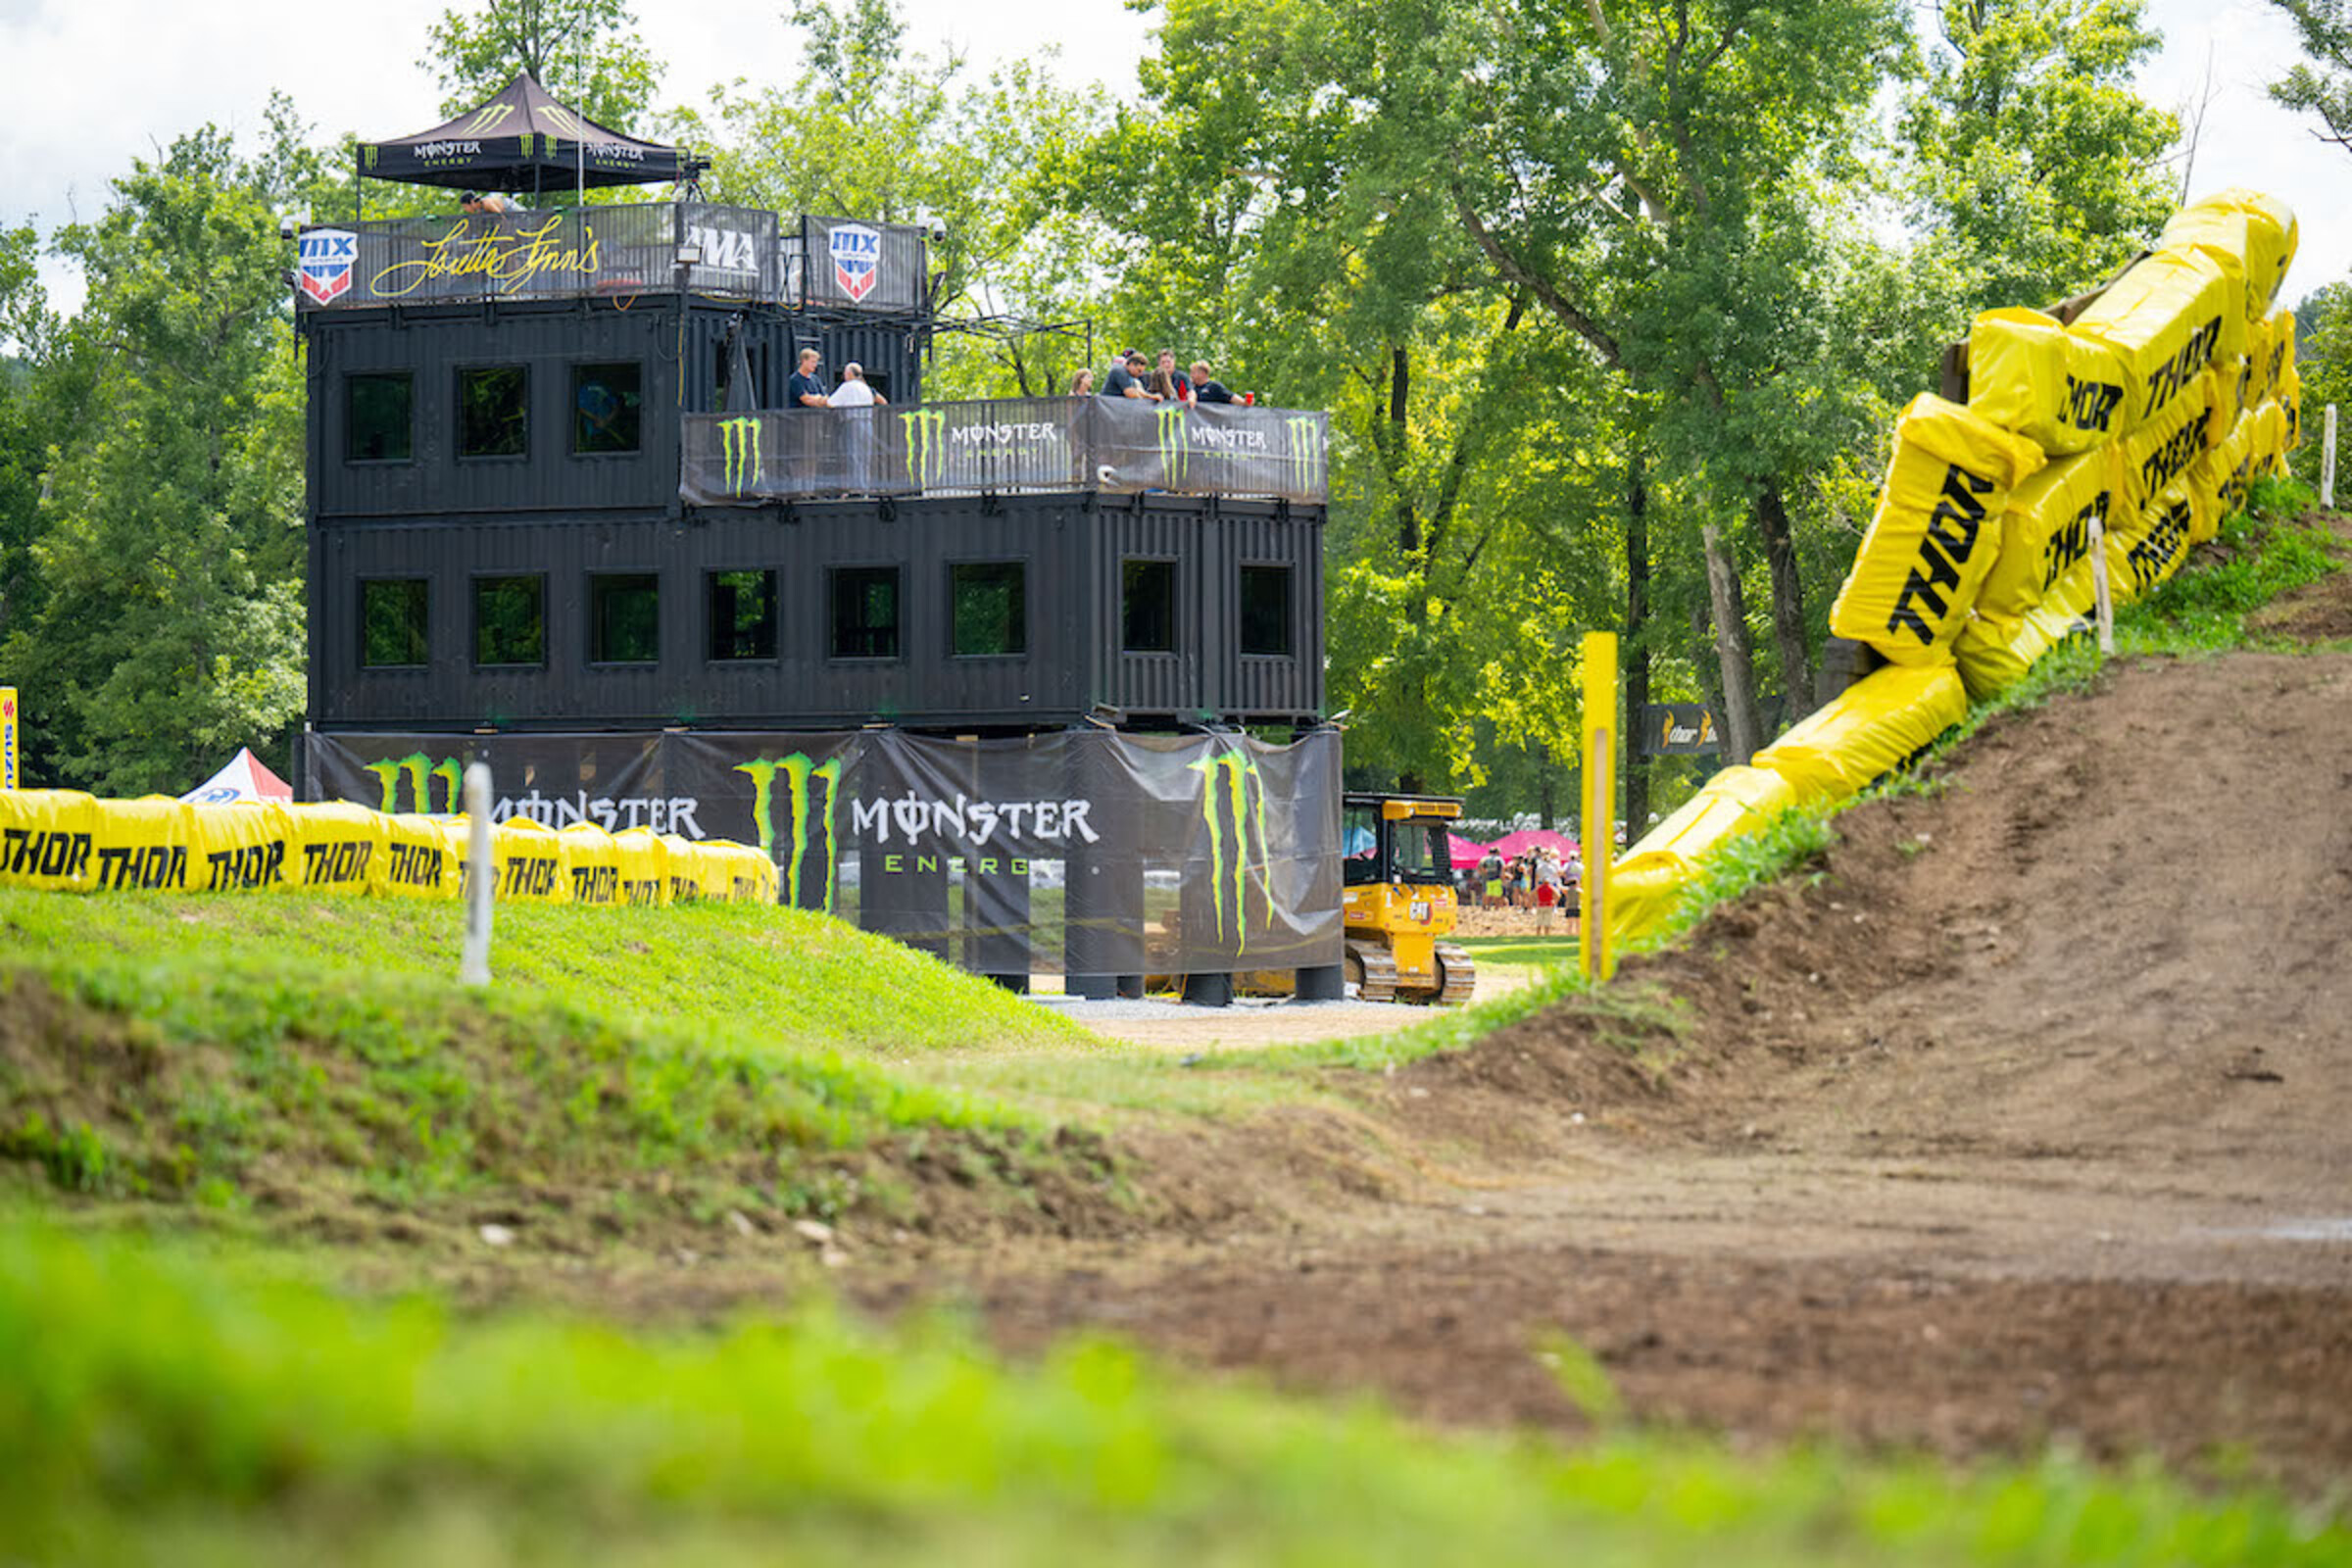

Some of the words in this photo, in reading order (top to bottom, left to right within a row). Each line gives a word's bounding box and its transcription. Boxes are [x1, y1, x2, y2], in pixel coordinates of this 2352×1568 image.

[415, 141, 481, 159] MONSTER
[300, 236, 355, 257] MX
[832, 231, 878, 253] MX
[2057, 373, 2124, 432] HOR
[952, 420, 1057, 447] MONSTER
[1192, 424, 1267, 450] MONSTER
[1887, 464, 1994, 646] THOR
[852, 790, 1100, 846] MONSTER
[0, 828, 91, 877] THOR
[99, 846, 187, 891] THOR
[208, 840, 285, 890] THOR
[304, 841, 372, 885] THOR
[388, 842, 442, 888] THOR
